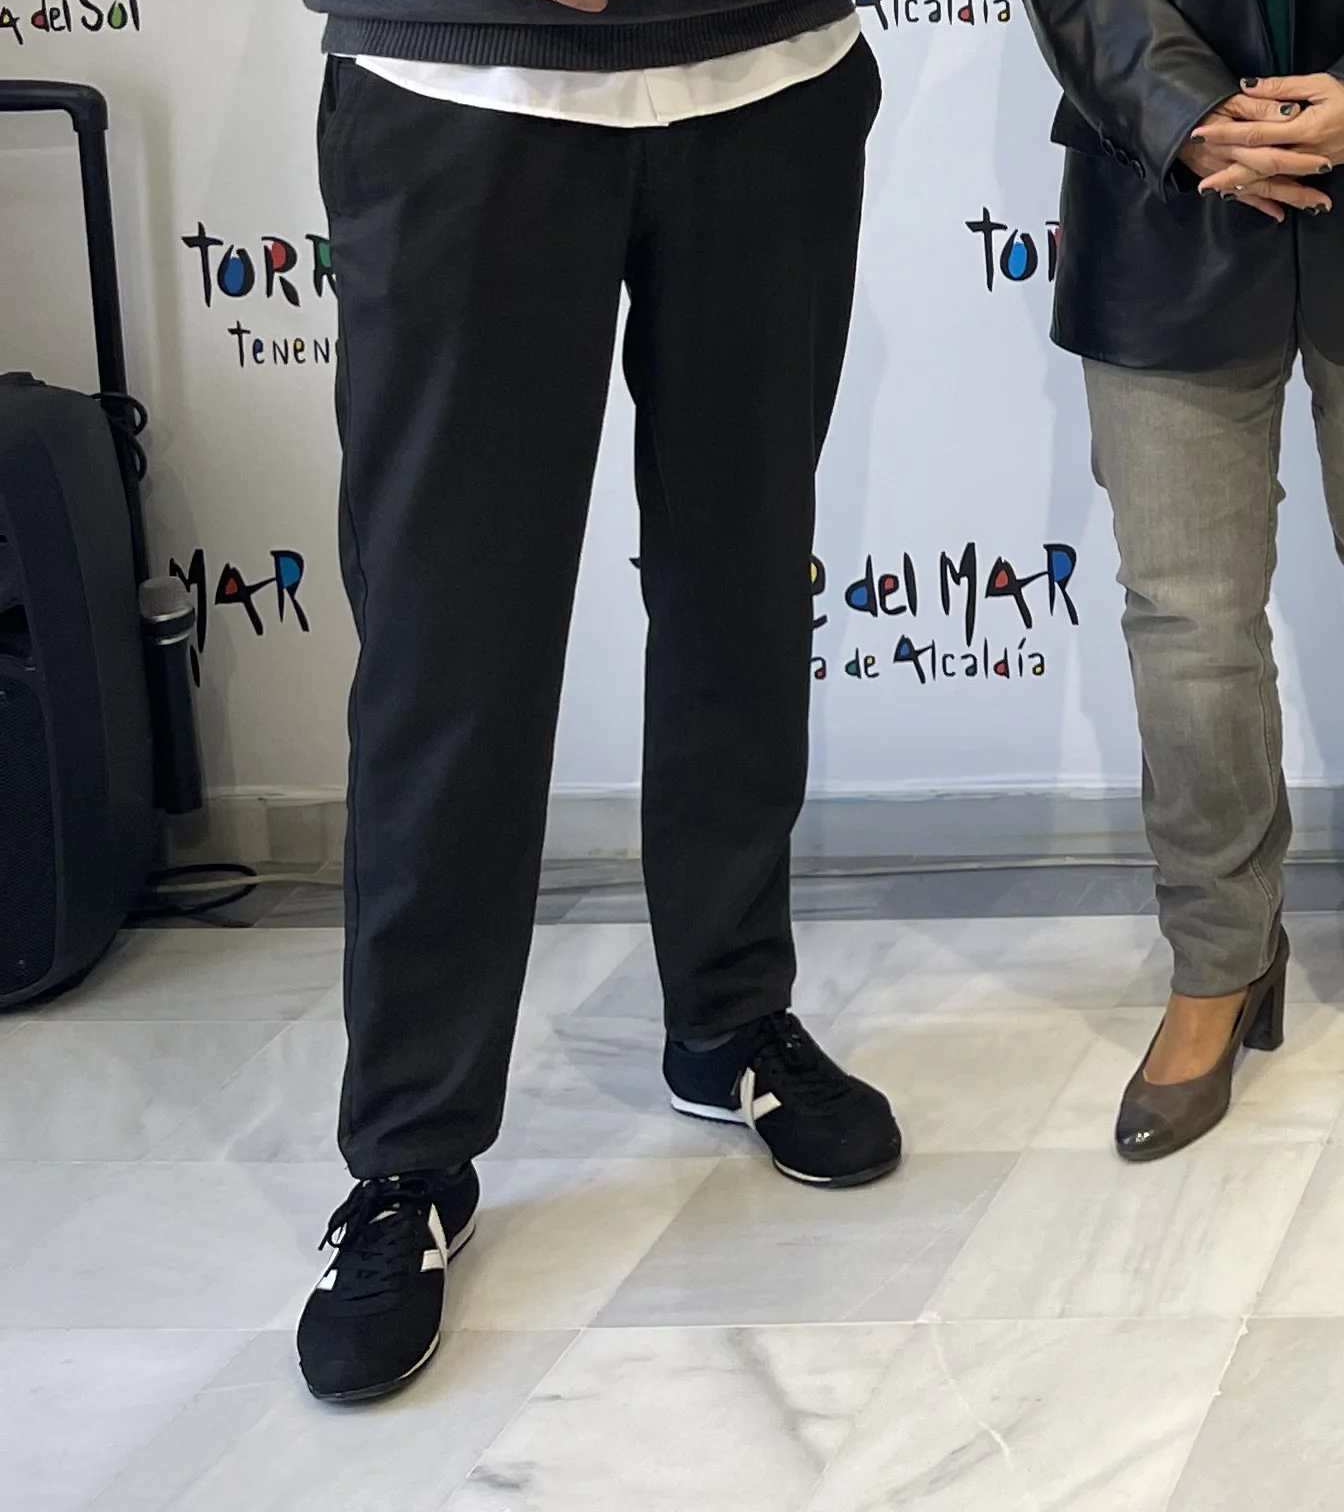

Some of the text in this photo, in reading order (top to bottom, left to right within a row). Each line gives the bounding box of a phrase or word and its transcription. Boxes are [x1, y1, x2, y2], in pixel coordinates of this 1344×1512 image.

[845, 553, 917, 617] del
[940, 543, 1078, 649] MAR
[845, 648, 879, 679] de
